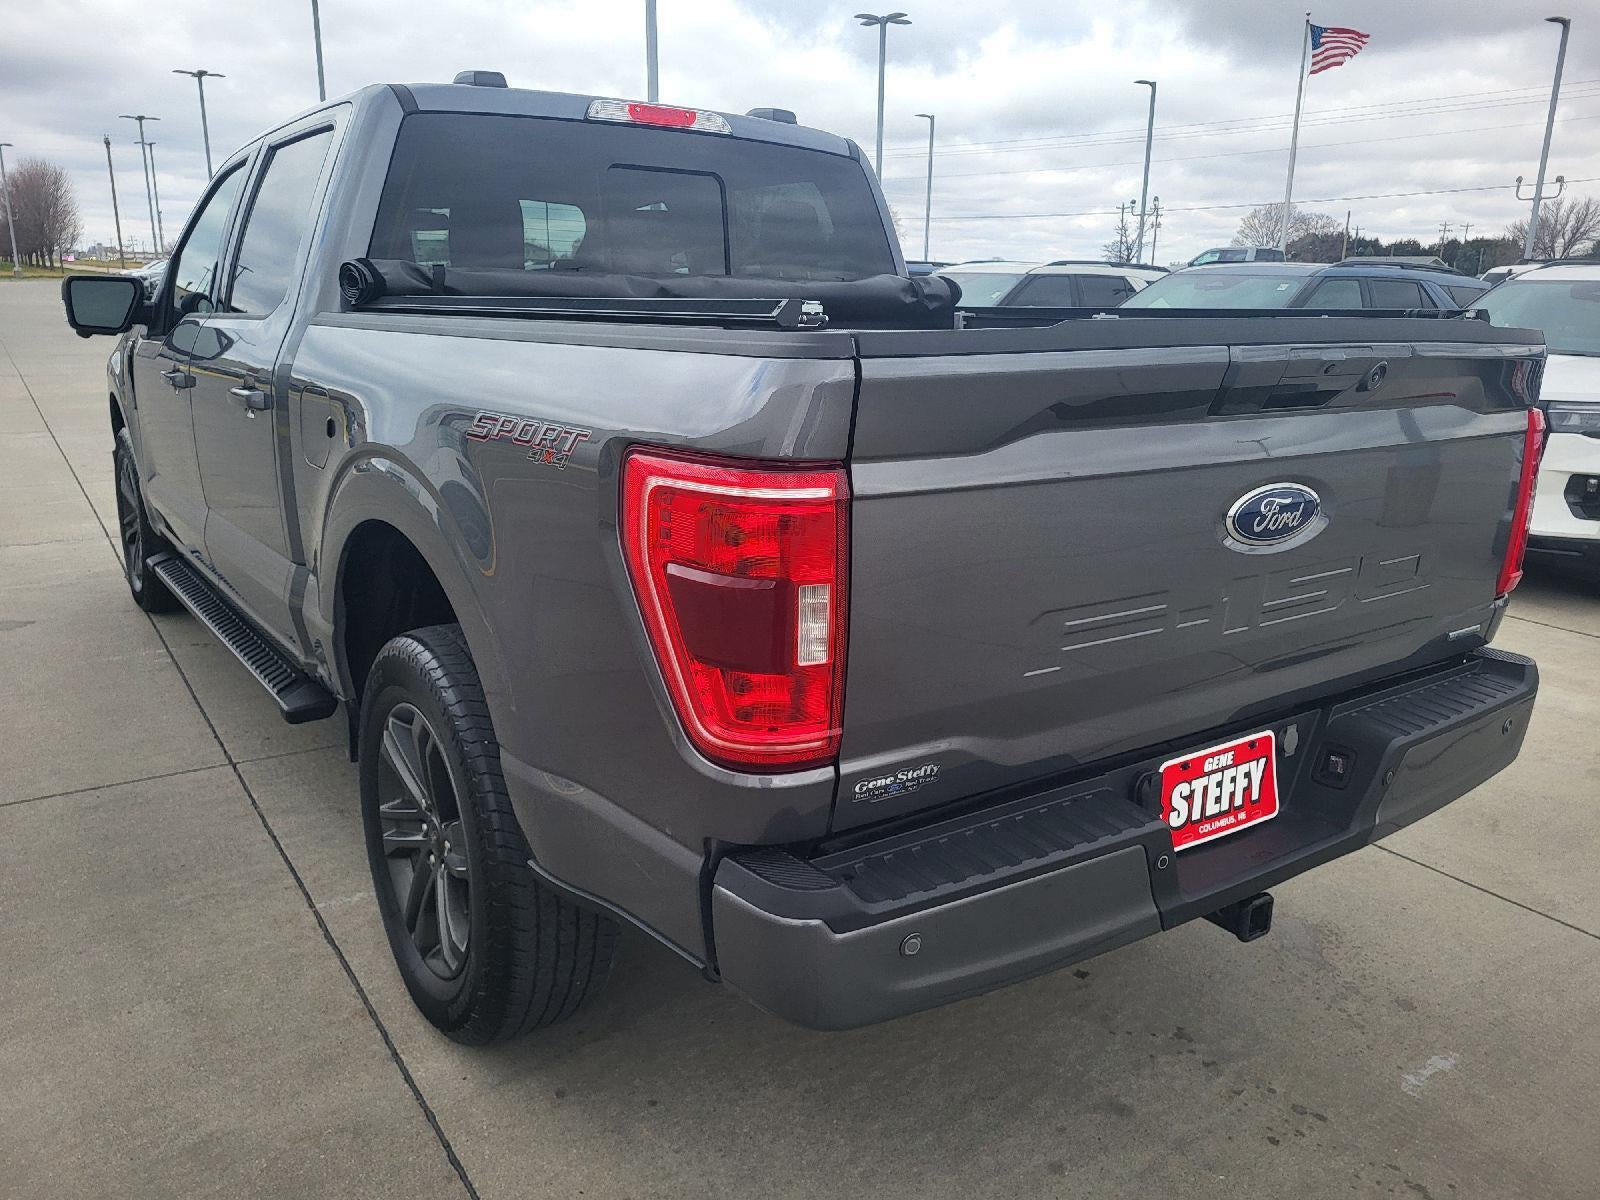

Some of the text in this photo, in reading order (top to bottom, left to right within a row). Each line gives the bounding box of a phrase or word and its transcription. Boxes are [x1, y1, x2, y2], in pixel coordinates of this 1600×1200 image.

[465, 410, 592, 455] SPORT
[1254, 496, 1304, 533] Ford
[1203, 751, 1235, 772] GENE
[855, 777, 894, 793] Gene
[896, 764, 940, 783] Steffy
[1169, 757, 1267, 828] STEFFY
[1198, 814, 1237, 833] COLUMBUS,
